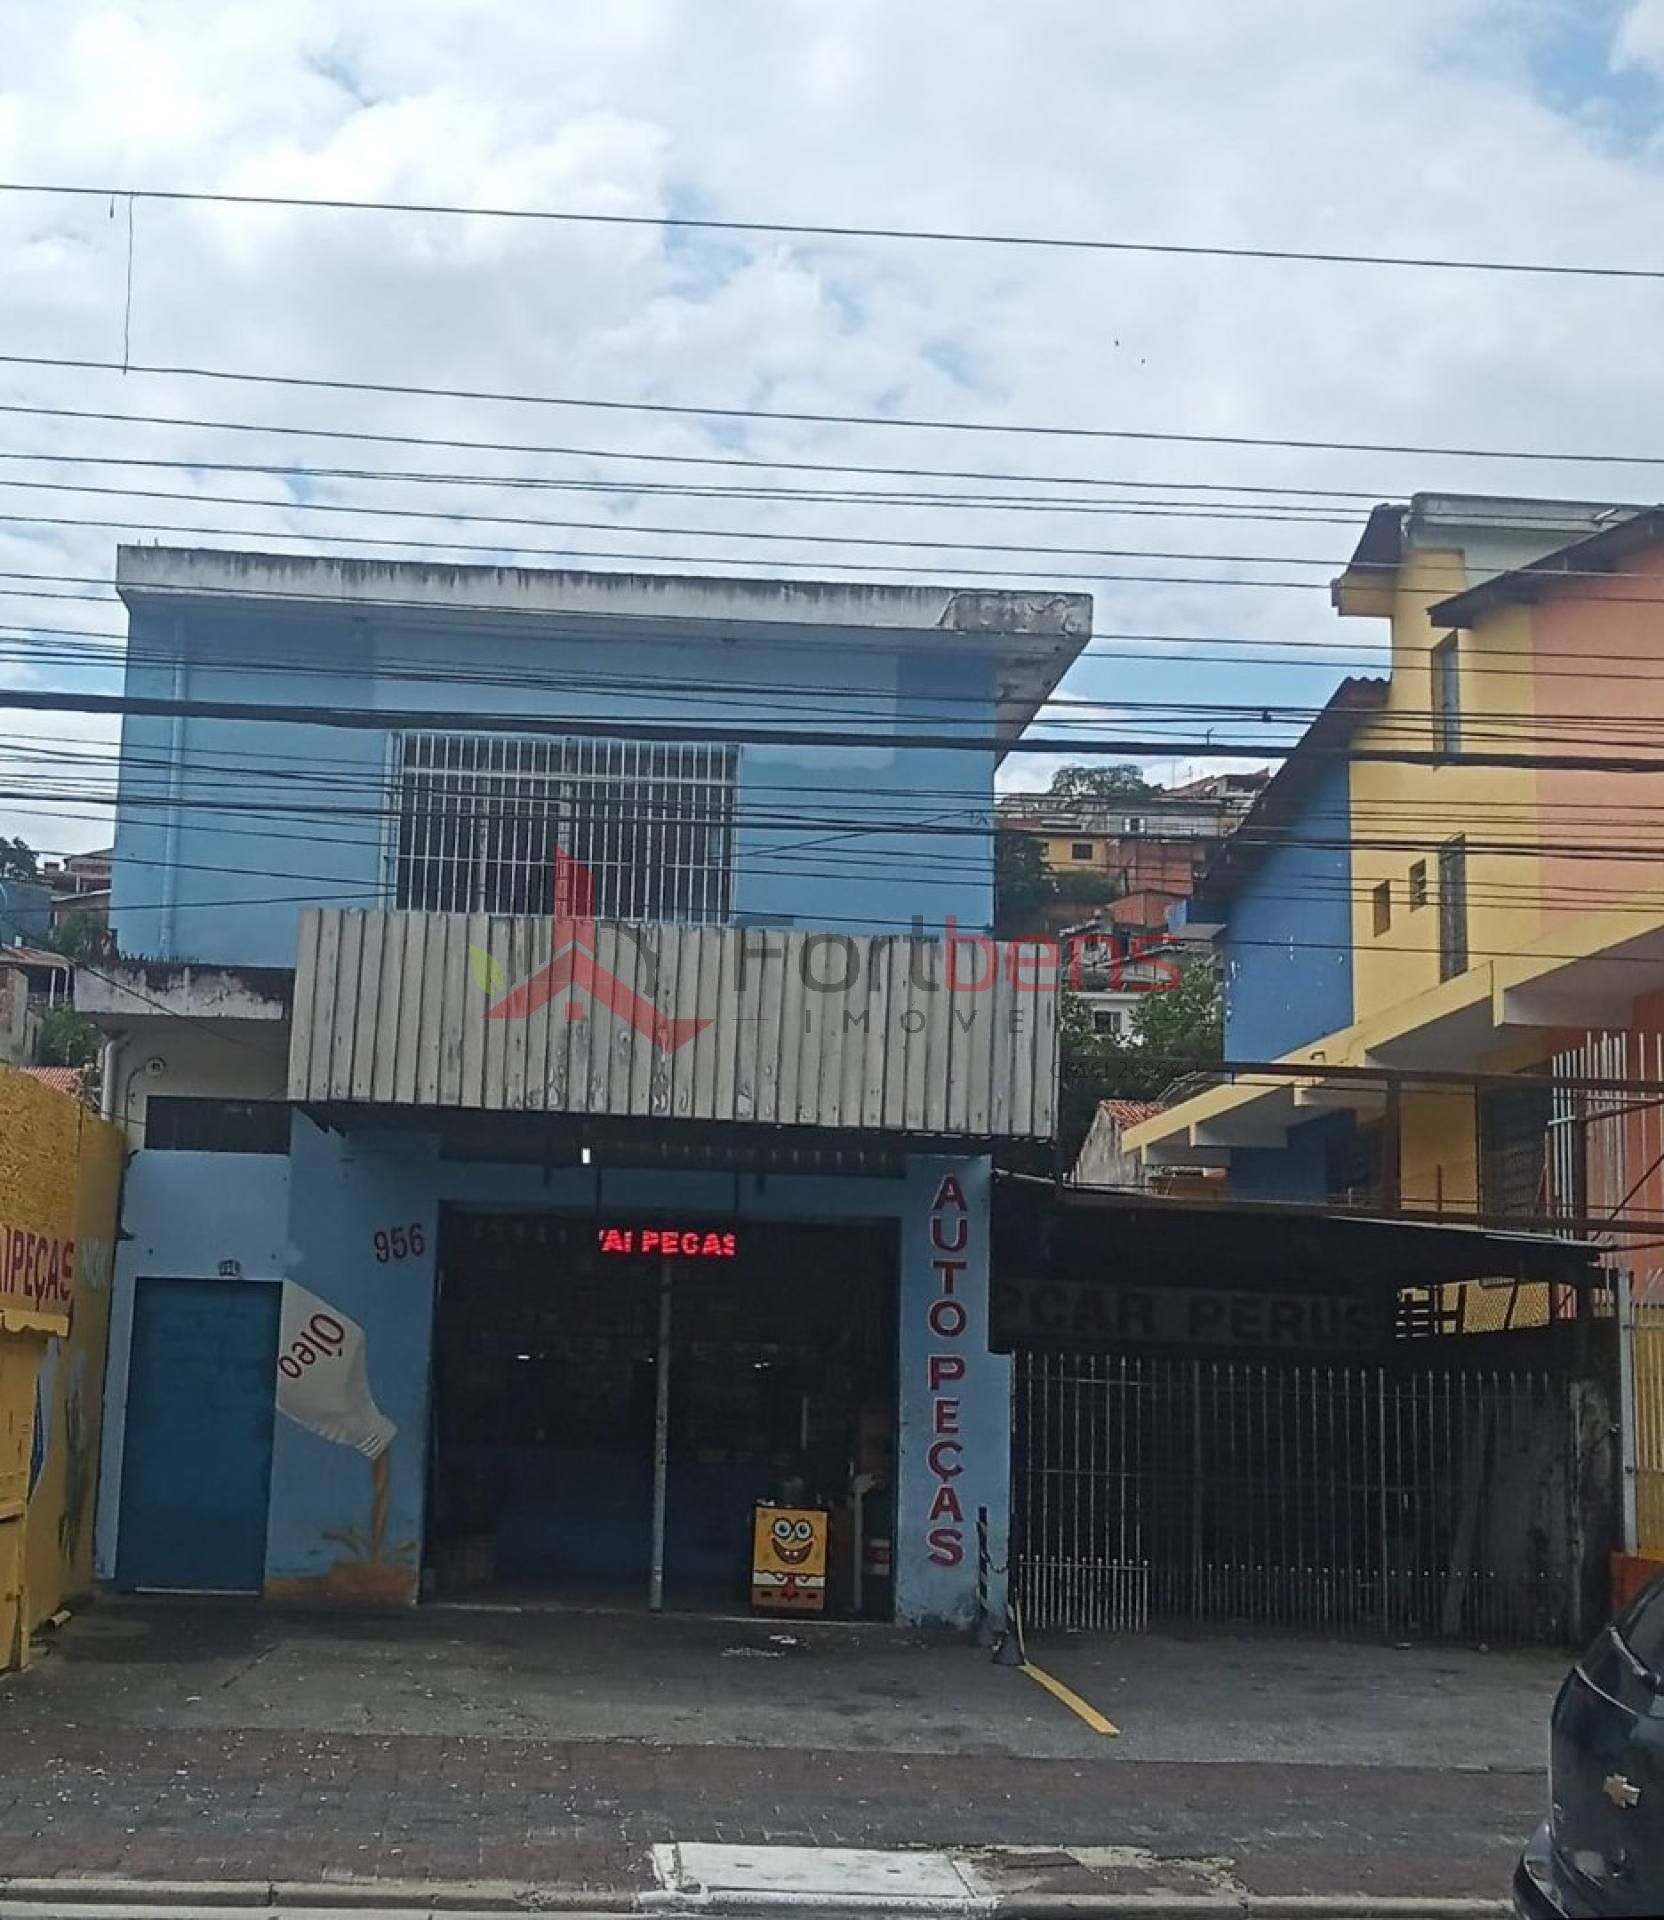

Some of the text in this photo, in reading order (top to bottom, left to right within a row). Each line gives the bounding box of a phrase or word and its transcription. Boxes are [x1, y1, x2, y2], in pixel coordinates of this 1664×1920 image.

[374, 1223, 425, 1264] 956
[278, 1313, 345, 1379] Óleo
[1189, 1295, 1368, 1345] PERUS
[927, 1173, 968, 1568] AUTO PEÇAS
